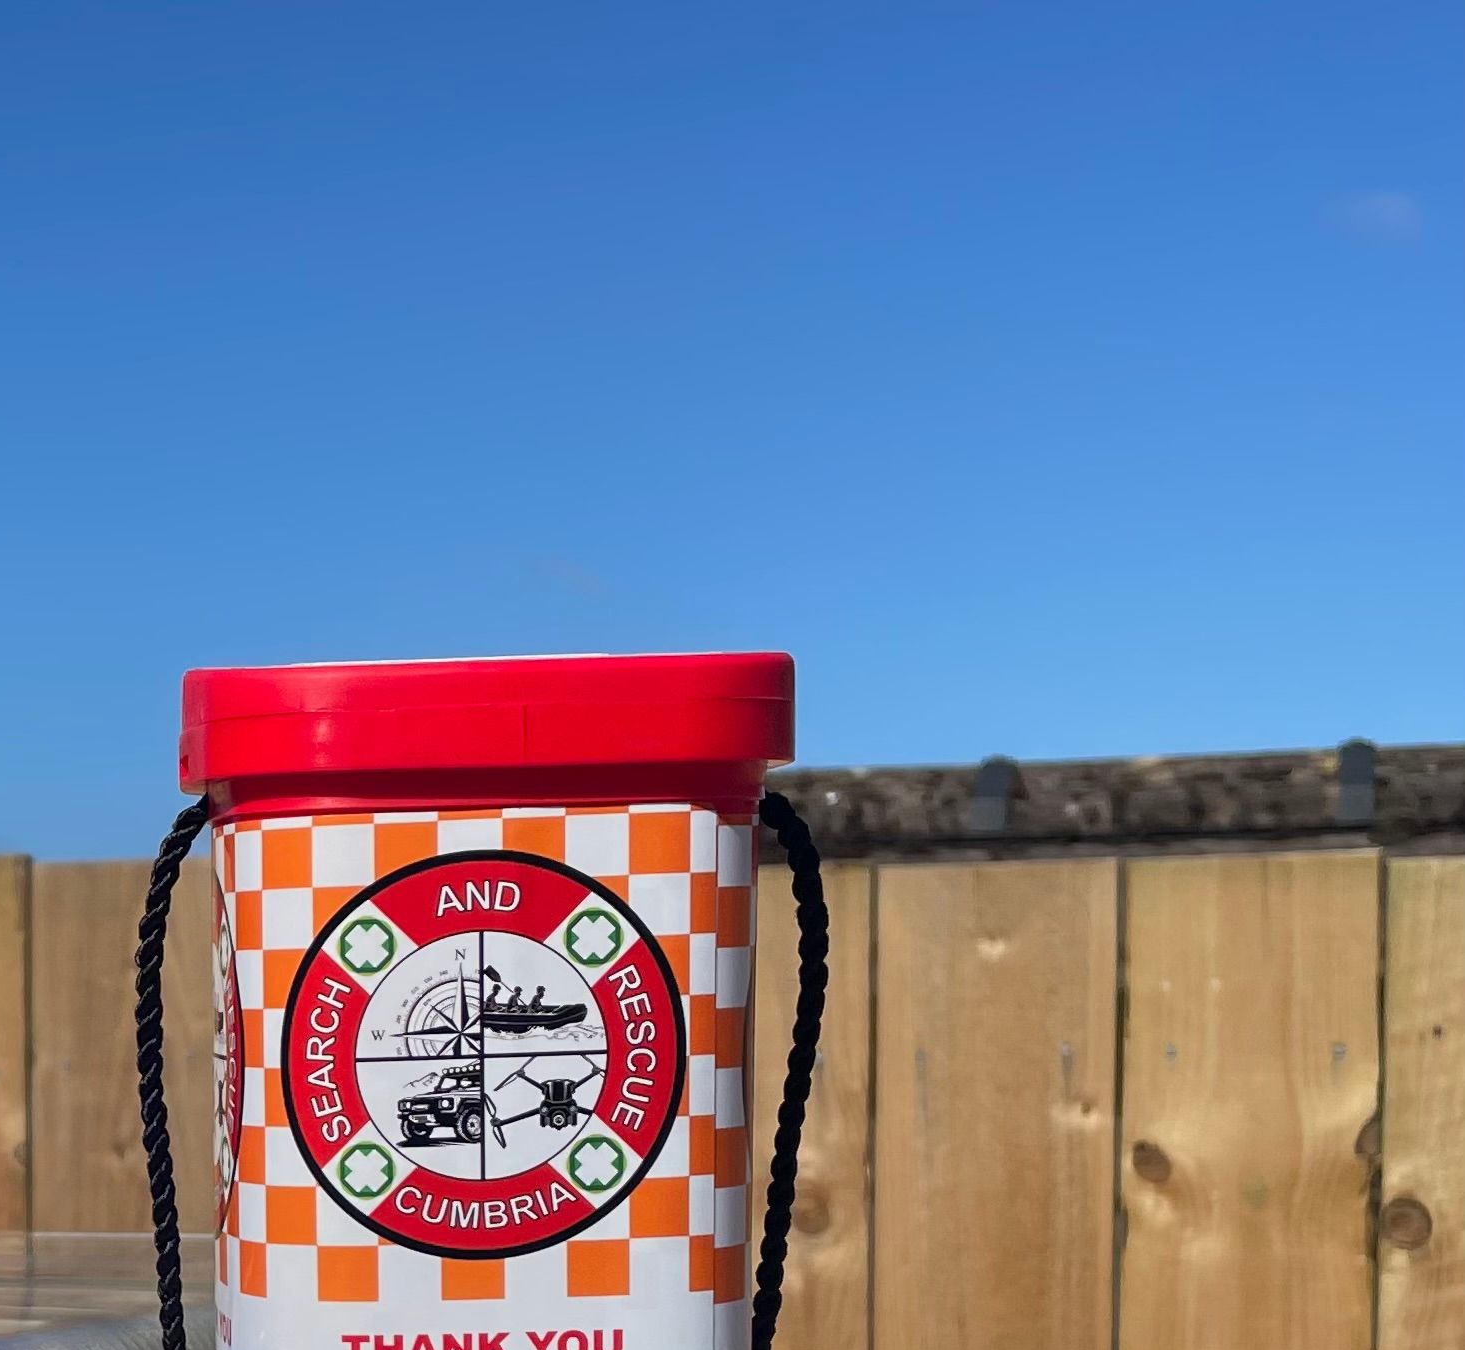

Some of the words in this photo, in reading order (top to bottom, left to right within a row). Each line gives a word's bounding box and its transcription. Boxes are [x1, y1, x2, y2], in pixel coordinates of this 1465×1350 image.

[454, 948, 466, 960] N
[305, 977, 352, 1143] SEARCH
[436, 879, 522, 918] AND
[607, 963, 657, 1131] RESCUE
[371, 1029, 385, 1041] W
[394, 1181, 578, 1230] CUMBRIA
